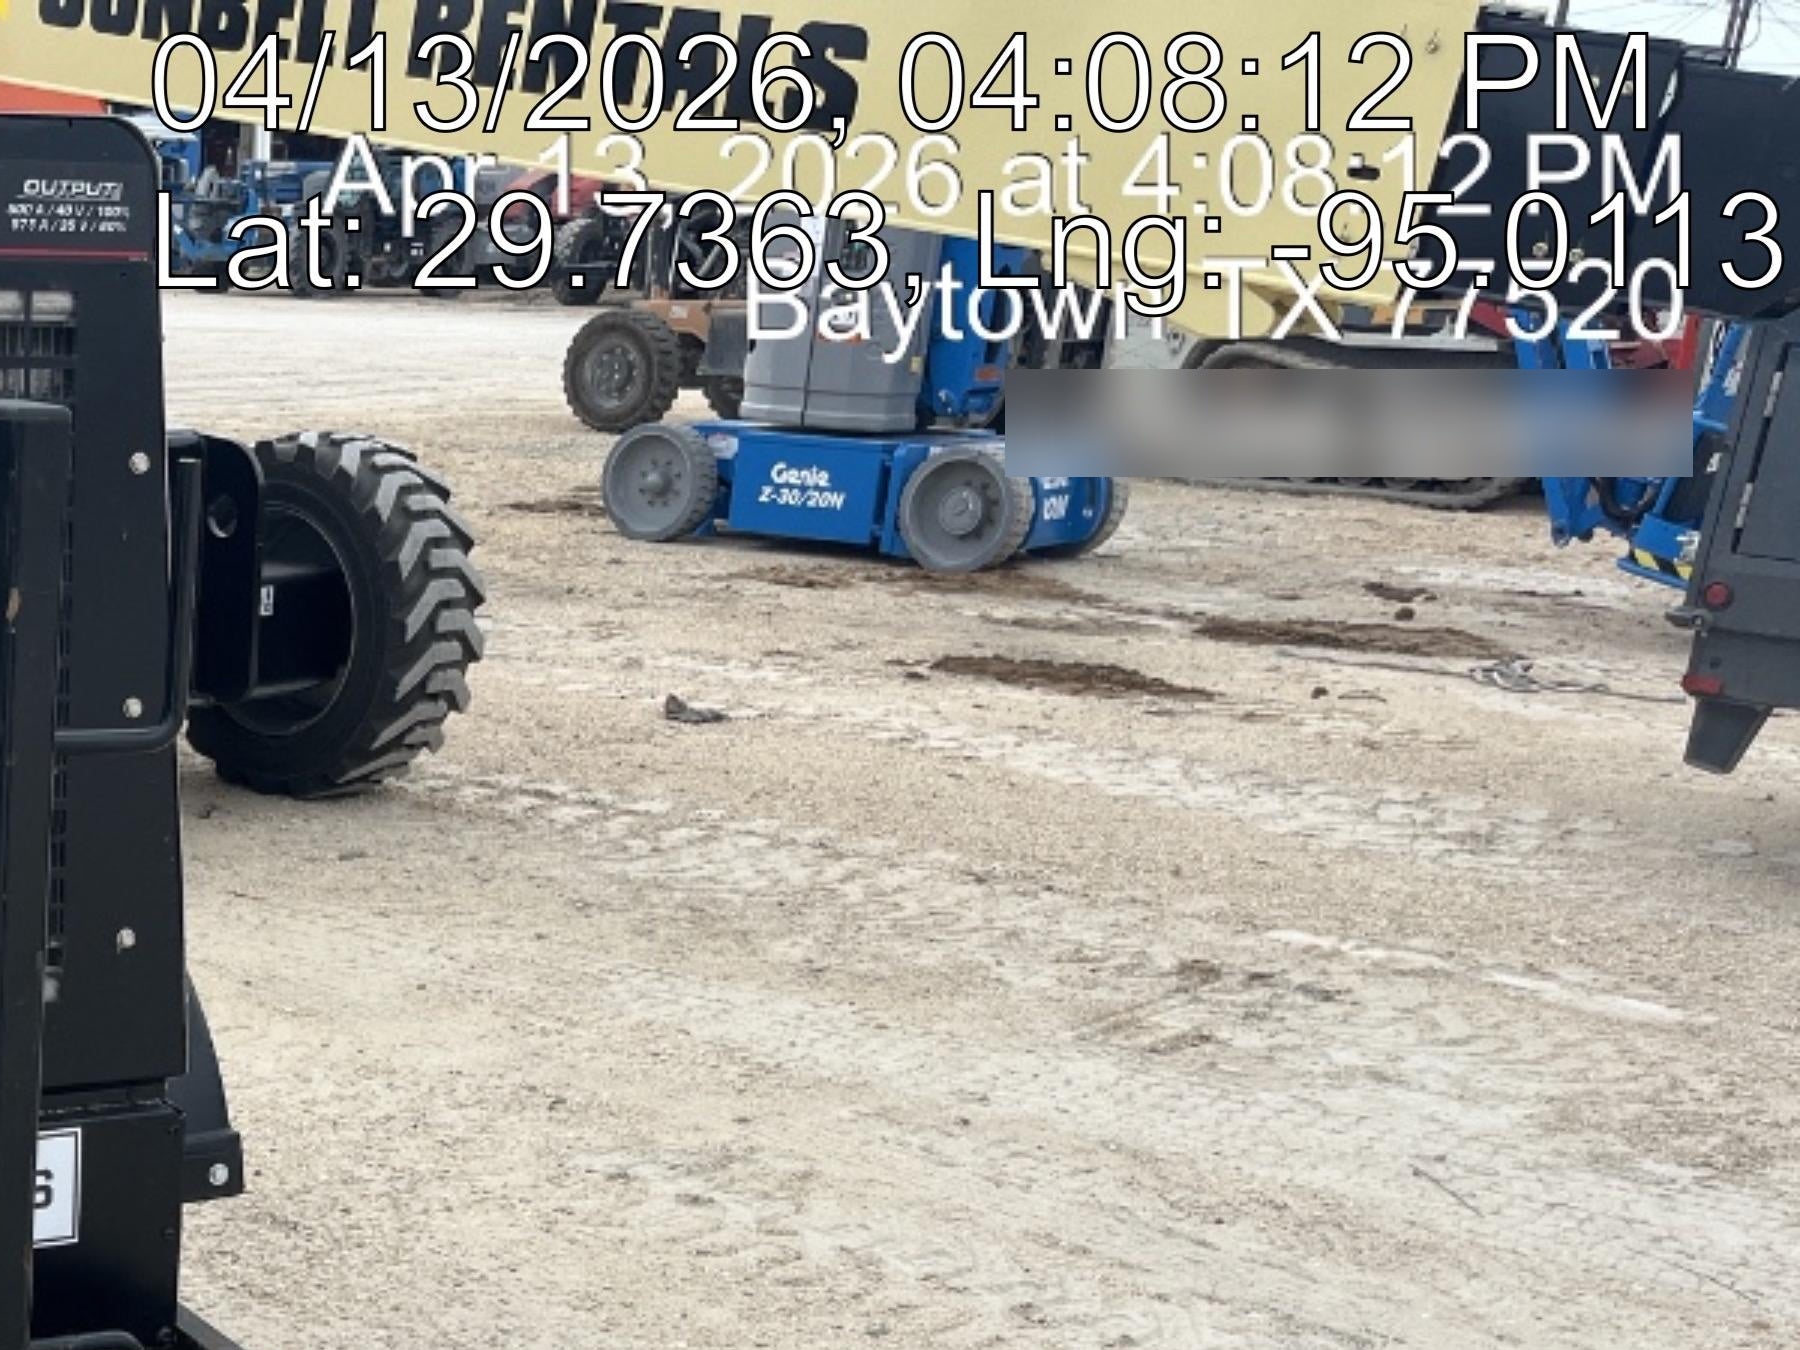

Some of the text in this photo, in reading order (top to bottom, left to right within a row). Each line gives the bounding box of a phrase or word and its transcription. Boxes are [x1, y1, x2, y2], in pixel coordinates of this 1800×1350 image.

[23, 179, 121, 197] OUTPUT
[770, 461, 831, 487] Genie
[758, 485, 846, 511] Z-30/20N
